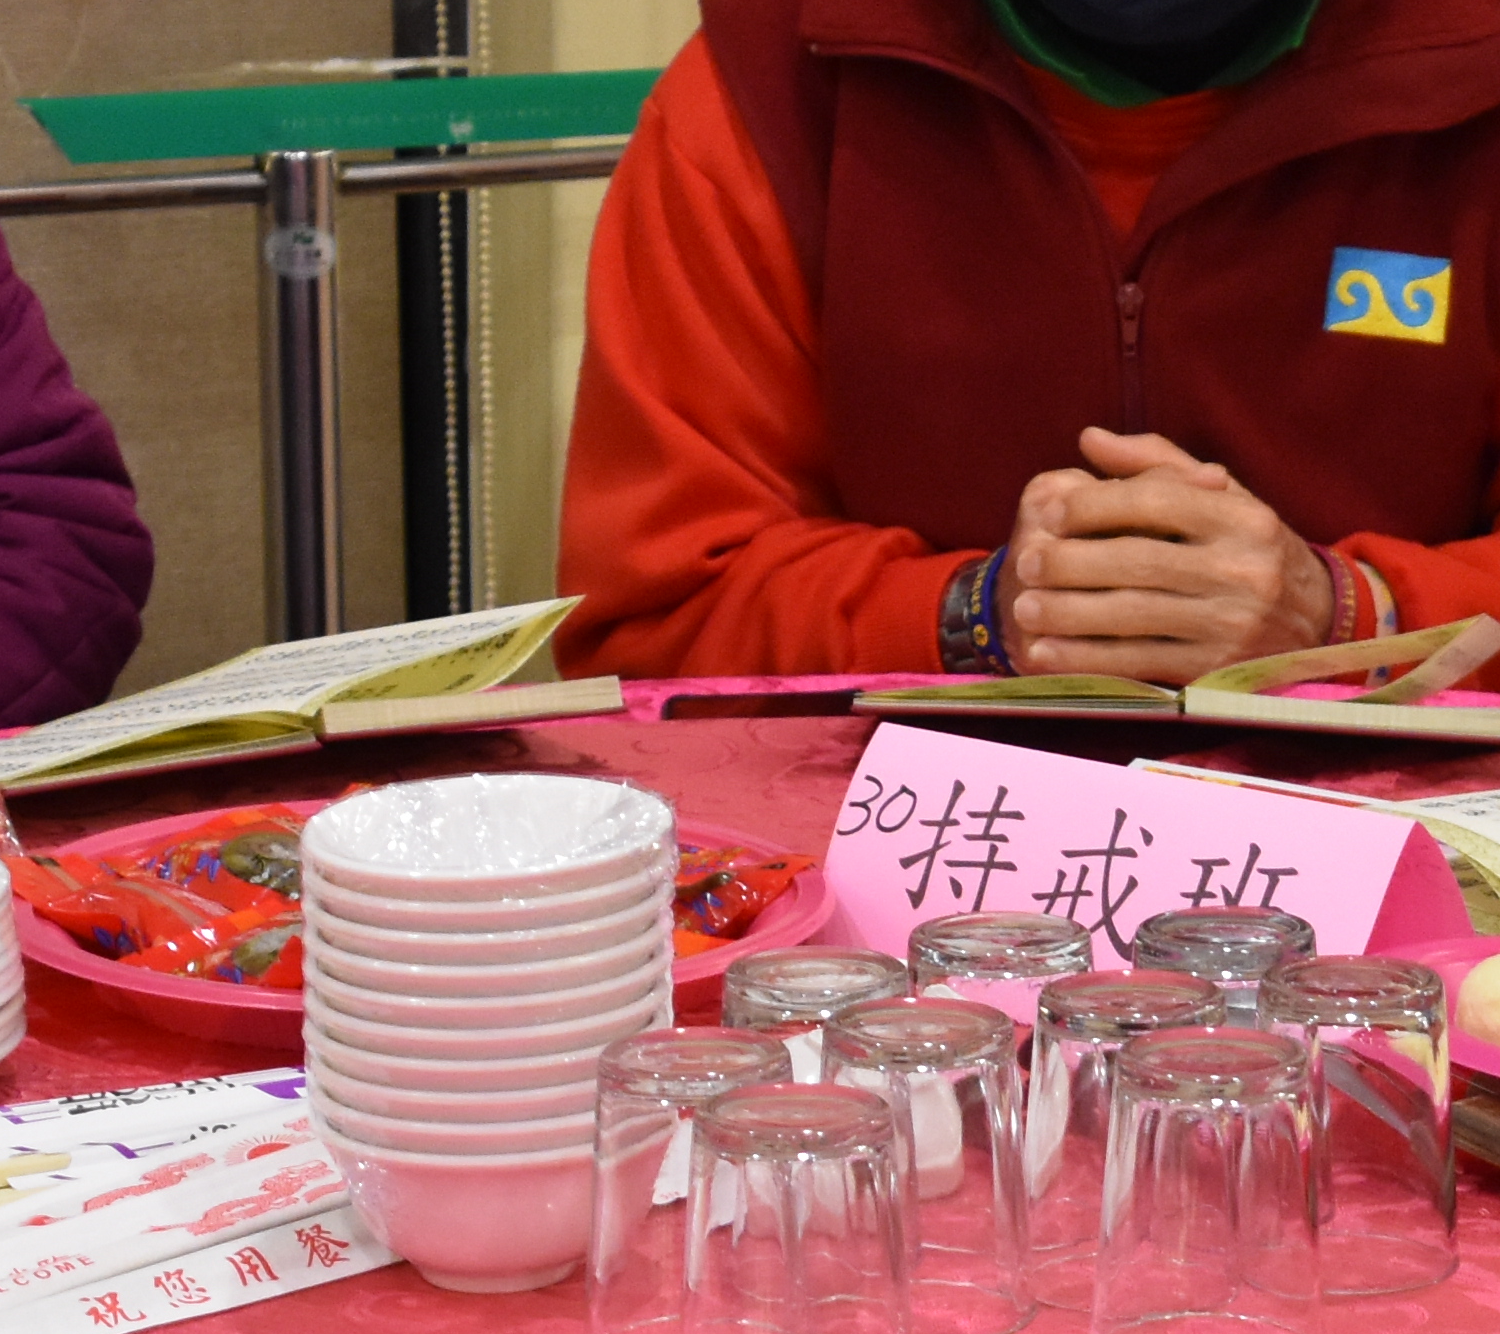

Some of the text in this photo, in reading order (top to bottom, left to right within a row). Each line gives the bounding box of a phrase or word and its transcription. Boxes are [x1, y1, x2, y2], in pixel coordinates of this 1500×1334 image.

[836, 774, 918, 836] 30
[85, 1222, 351, 1329] 祝您用餐
